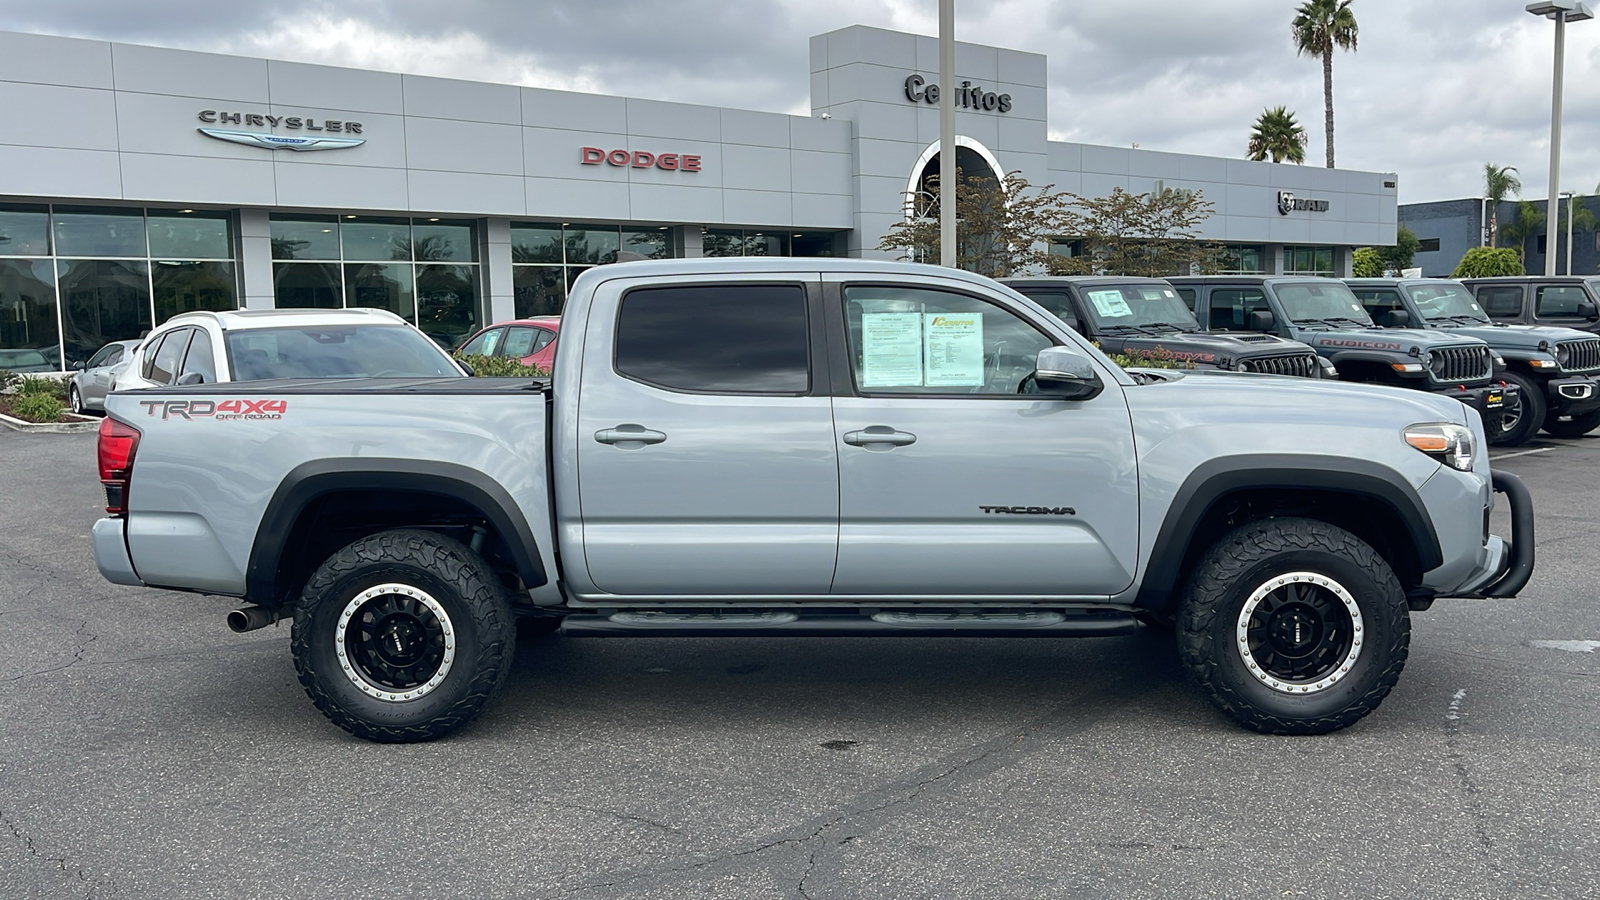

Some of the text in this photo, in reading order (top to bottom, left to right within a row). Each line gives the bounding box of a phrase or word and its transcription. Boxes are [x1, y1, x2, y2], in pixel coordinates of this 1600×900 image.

[904, 74, 1013, 113] Ceritos
[198, 110, 363, 134] CHRYSLER
[580, 146, 702, 172] DODGE
[1292, 198, 1330, 212] RAM
[1319, 339, 1402, 350] RUBICON
[978, 505, 1077, 516] TACOMA
